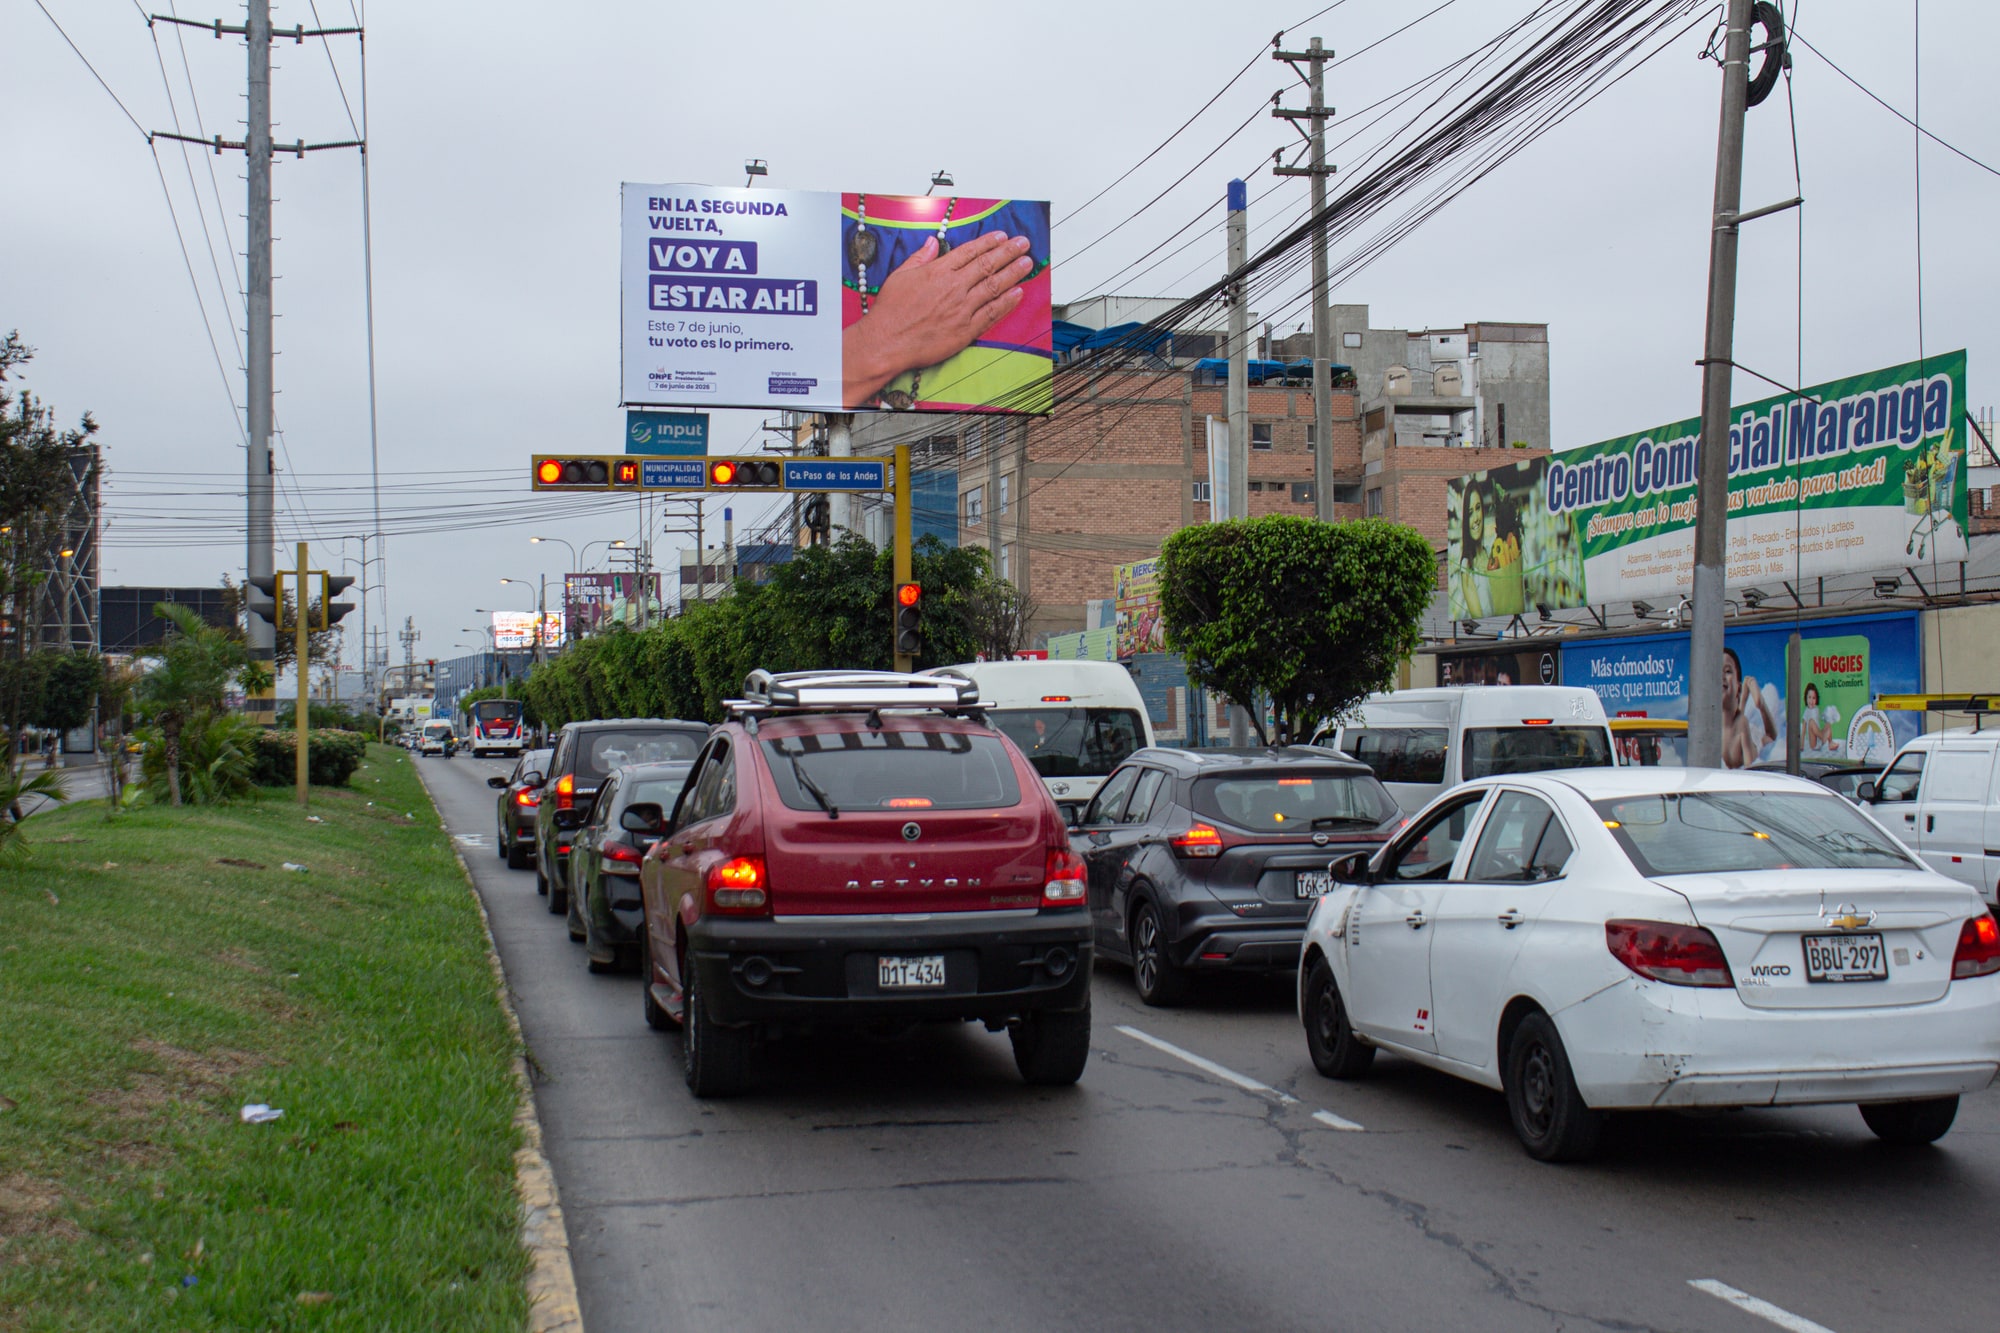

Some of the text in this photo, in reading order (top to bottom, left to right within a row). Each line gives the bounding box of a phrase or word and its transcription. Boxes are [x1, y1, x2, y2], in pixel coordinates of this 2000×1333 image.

[649, 197, 788, 216] EN LA SEGUNDA
[649, 216, 723, 236] VUELTA,
[653, 245, 747, 270] VOY A
[653, 282, 812, 312] ESTAR AHÍ.
[648, 320, 744, 336] Este 7 de junio,
[648, 336, 794, 352] tu voto es lo primero.
[658, 424, 702, 438] input
[1548, 457, 1628, 512] Centro
[1788, 380, 1948, 460] Maranga
[675, 476, 701, 484] MIGUEL
[803, 471, 822, 480] Paso
[826, 471, 835, 480] de
[840, 471, 850, 480] los
[854, 471, 878, 480] Andes
[1636, 511, 1656, 526] con
[1657, 502, 1669, 522] lo
[1747, 479, 1797, 506] variado
[1801, 474, 1835, 500] para
[1839, 458, 1885, 489] usted!
[1658, 547, 1682, 559] Verduras
[1732, 536, 1747, 548] Pollo
[1752, 531, 1779, 544] Pescado
[1821, 526, 1826, 537] y
[1827, 521, 1854, 534] Lacteos
[1621, 568, 1646, 579] Productos
[1648, 563, 1672, 576] Naturales
[1733, 550, 1760, 562] Comidas
[1766, 546, 1784, 558] Bazar
[1825, 539, 1833, 550] de
[1835, 535, 1864, 549] limpieza
[1764, 565, 1768, 576] y
[1591, 655, 1674, 678] Más cómodos y
[1813, 655, 1863, 674] HUGGIES
[1622, 682, 1646, 702] que
[1824, 678, 1863, 688] Soft Comfort
[846, 878, 982, 889] ACTYON
[1830, 937, 1856, 945] PERU
[1810, 946, 1879, 971] BBU-297
[882, 964, 943, 985] D1T-434
